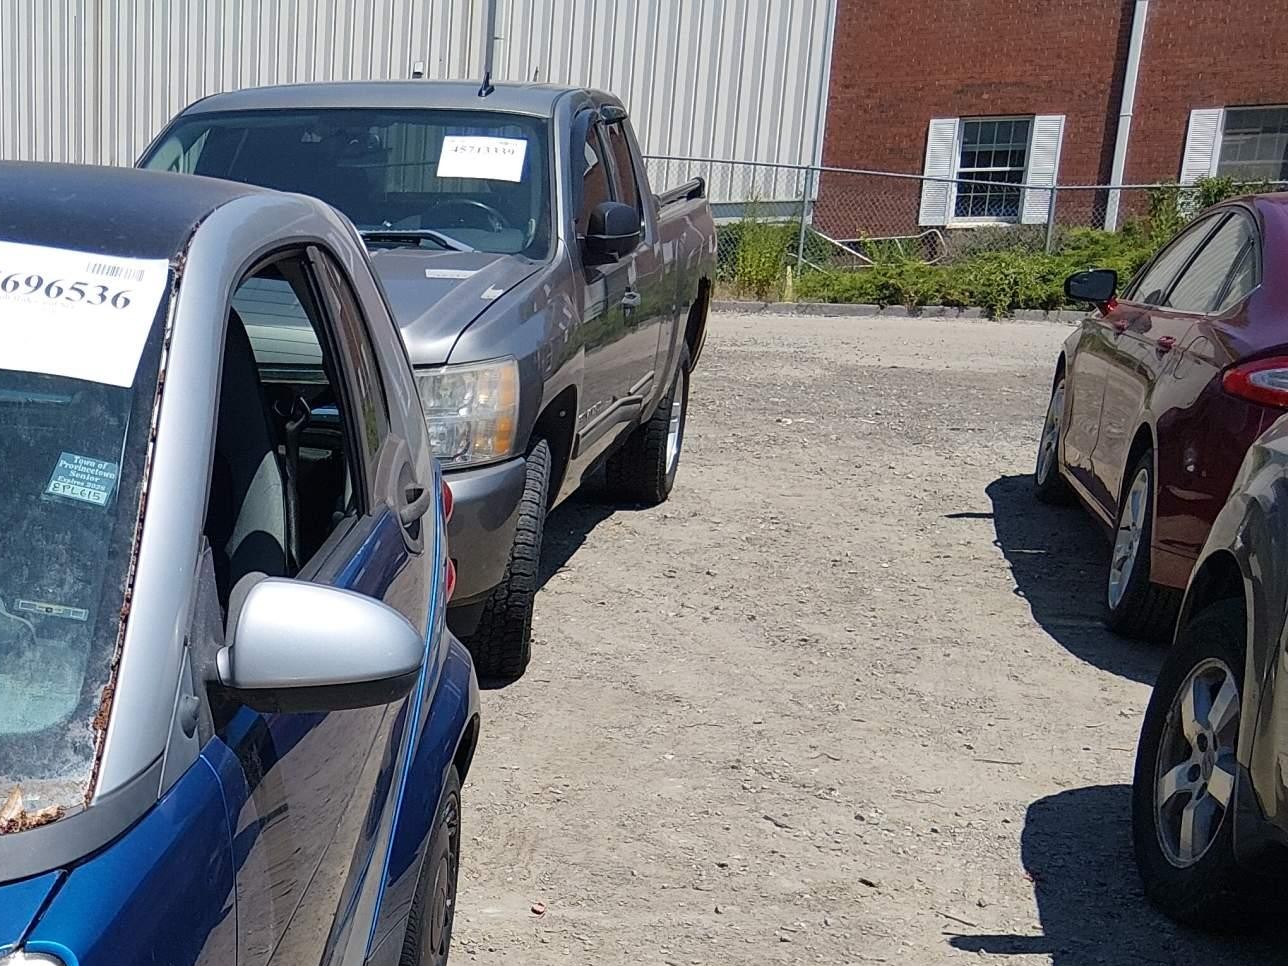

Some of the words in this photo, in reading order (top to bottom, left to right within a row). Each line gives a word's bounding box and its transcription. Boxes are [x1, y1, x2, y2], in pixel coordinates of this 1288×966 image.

[73, 456, 96, 468] Town
[58, 460, 116, 480] Provincetown
[69, 470, 102, 482] Senior
